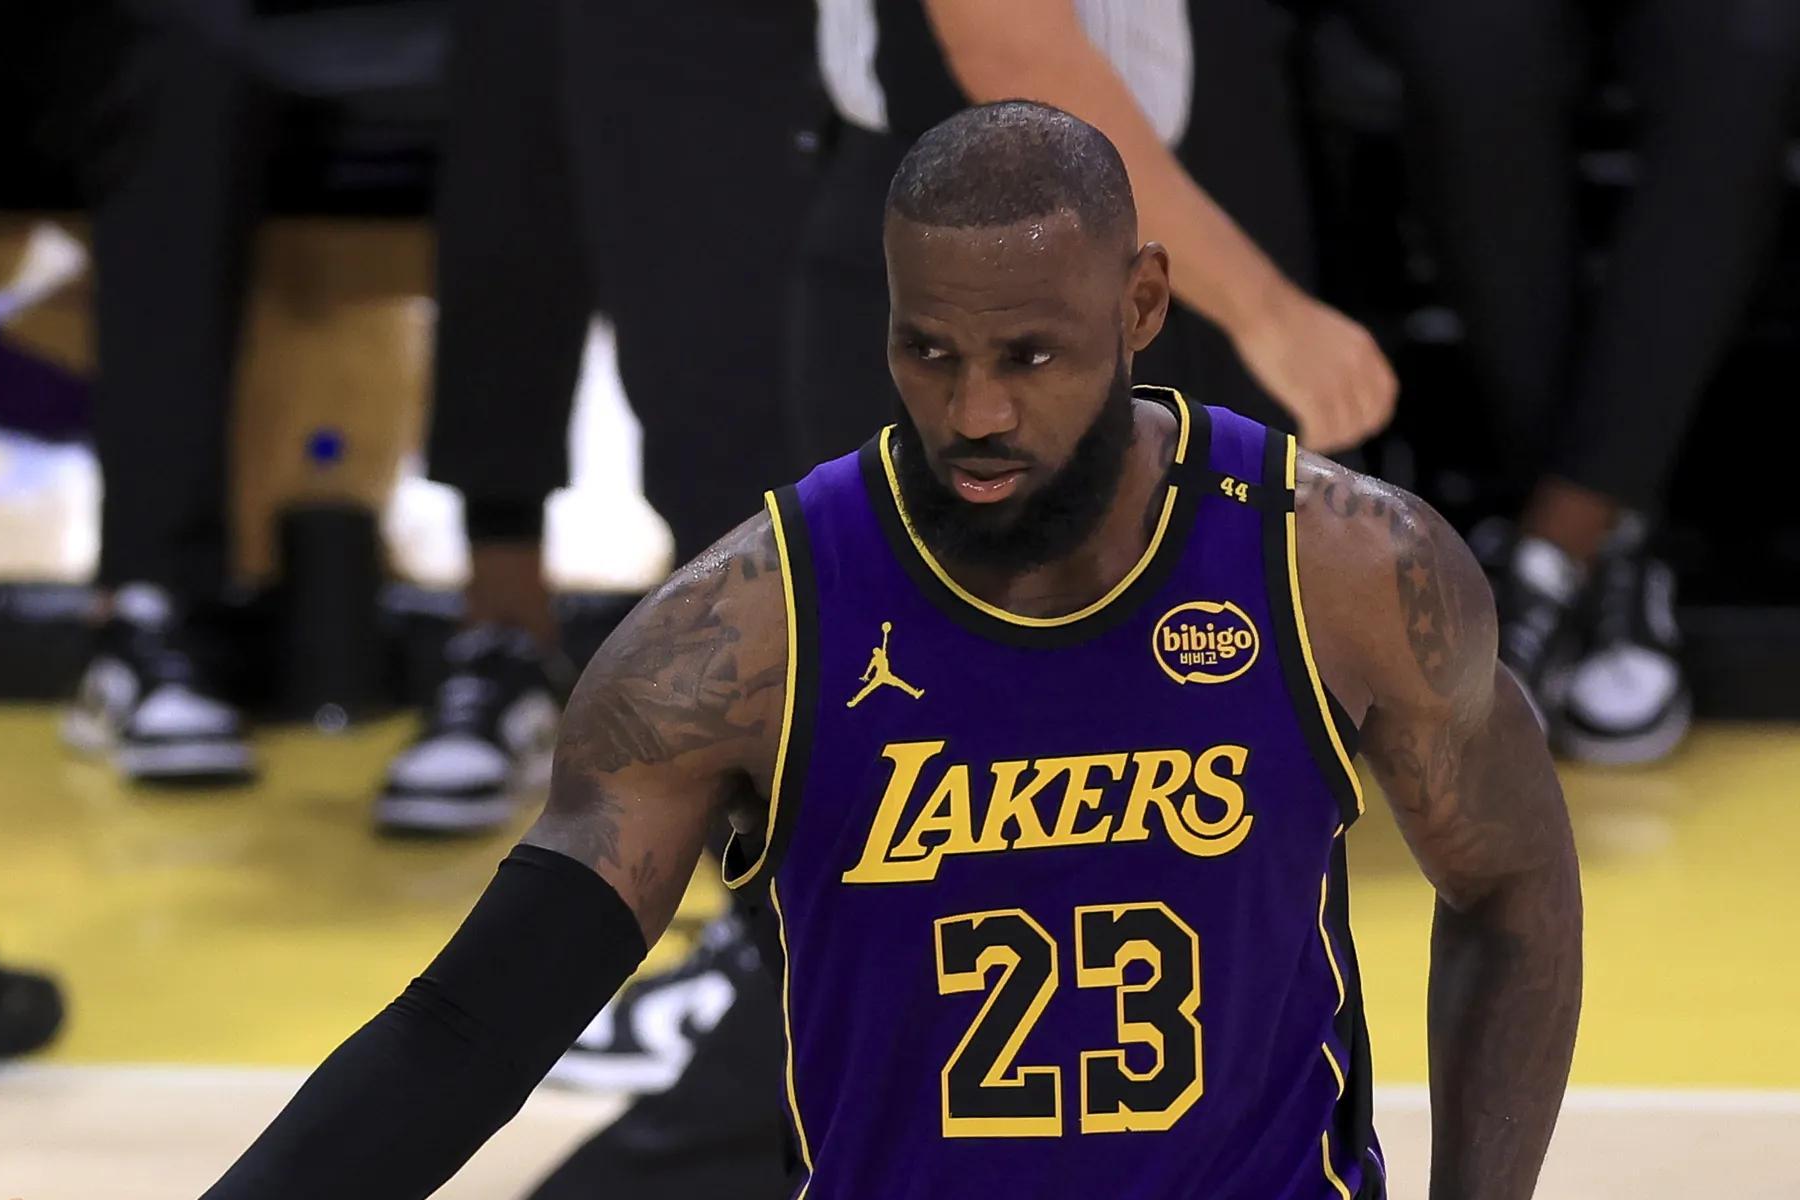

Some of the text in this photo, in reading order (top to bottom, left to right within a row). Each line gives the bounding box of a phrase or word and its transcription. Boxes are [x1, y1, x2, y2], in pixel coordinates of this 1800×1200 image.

[1221, 477, 1248, 502] 44
[1163, 623, 1252, 658] bibigo
[1180, 652, 1218, 665] 비비고
[842, 740, 1253, 883] LAKERS
[934, 902, 1203, 1137] 23
